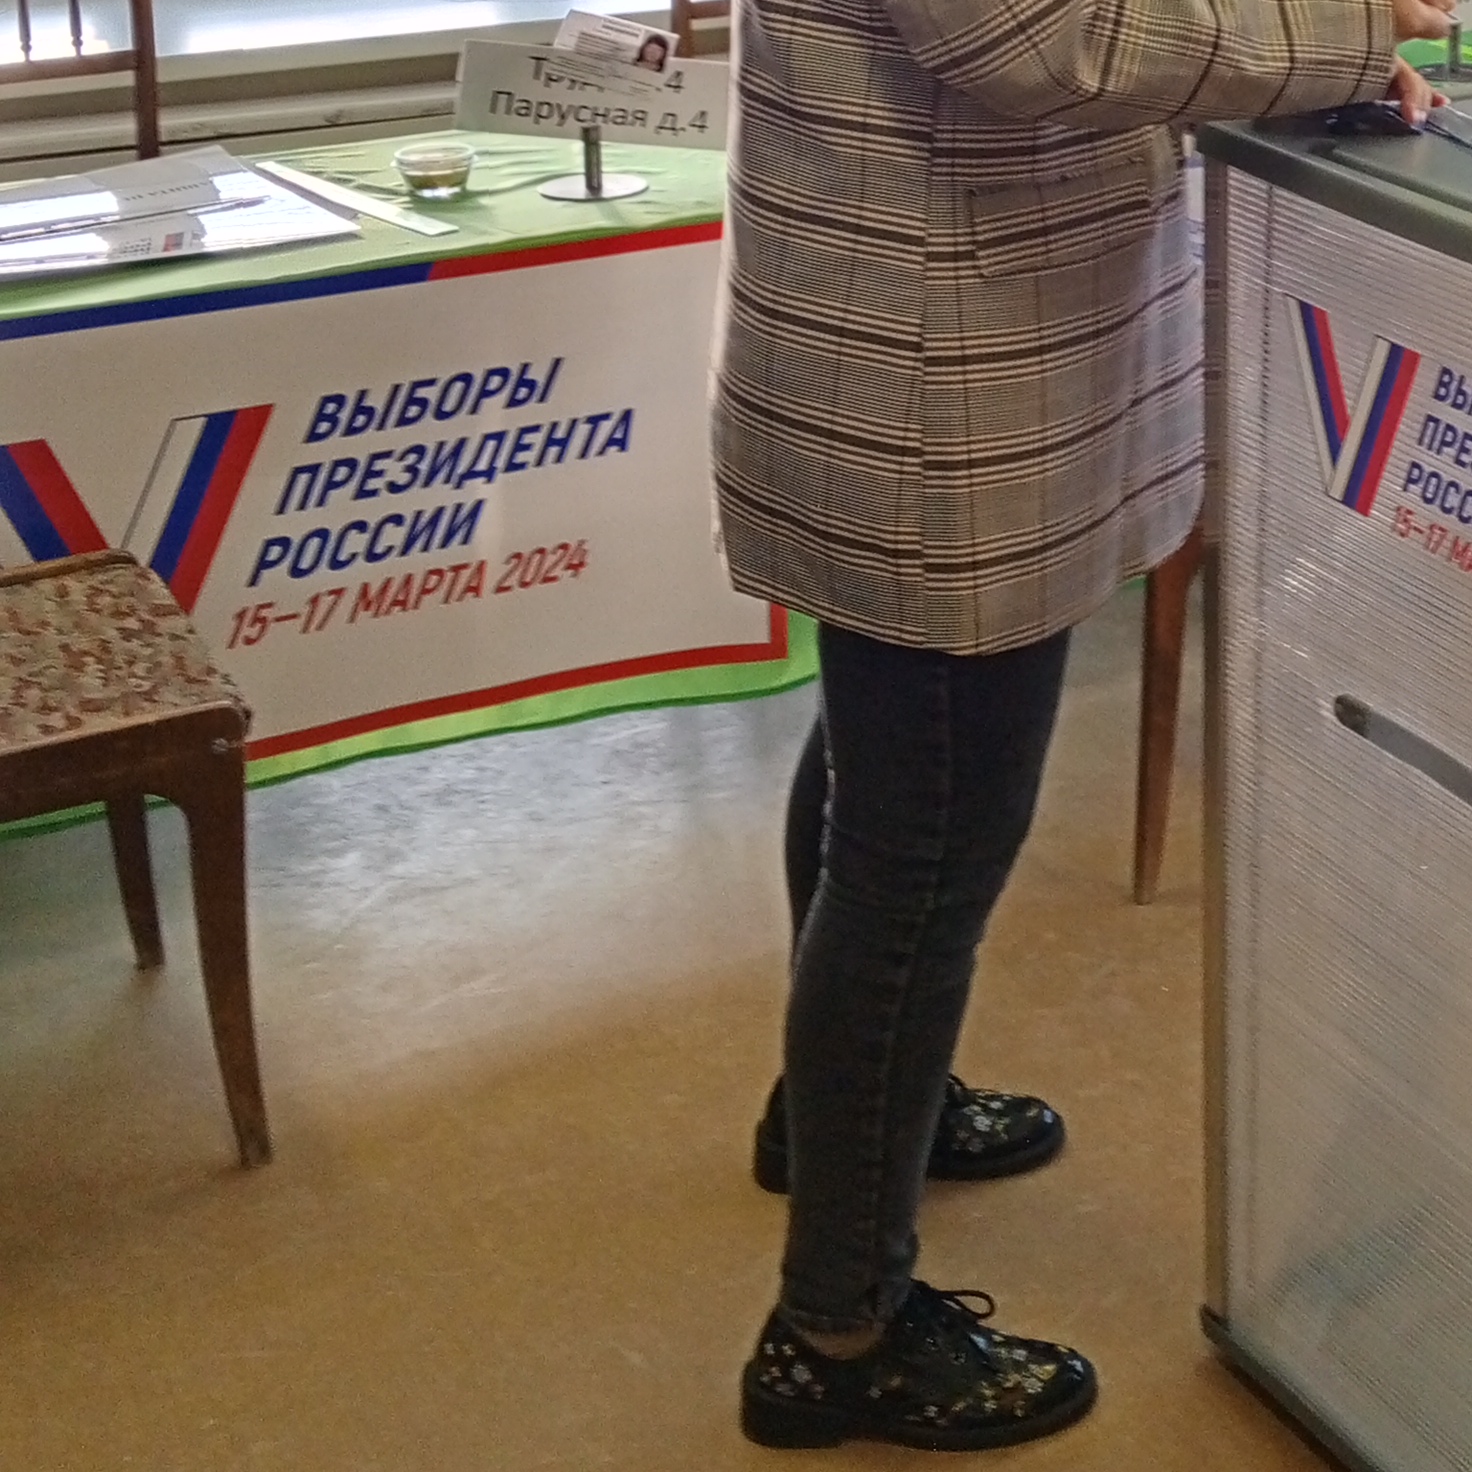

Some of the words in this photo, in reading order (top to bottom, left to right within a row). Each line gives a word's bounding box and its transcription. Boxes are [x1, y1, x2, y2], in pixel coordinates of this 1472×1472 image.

[488, 89, 650, 129] Парусная
[303, 357, 564, 444] ВЫБОРЫ
[274, 408, 636, 516] ПРЕЗИДЕНТА
[246, 498, 487, 588] РОССИИ
[349, 560, 488, 624] МАРТА
[494, 539, 589, 594] 2024
